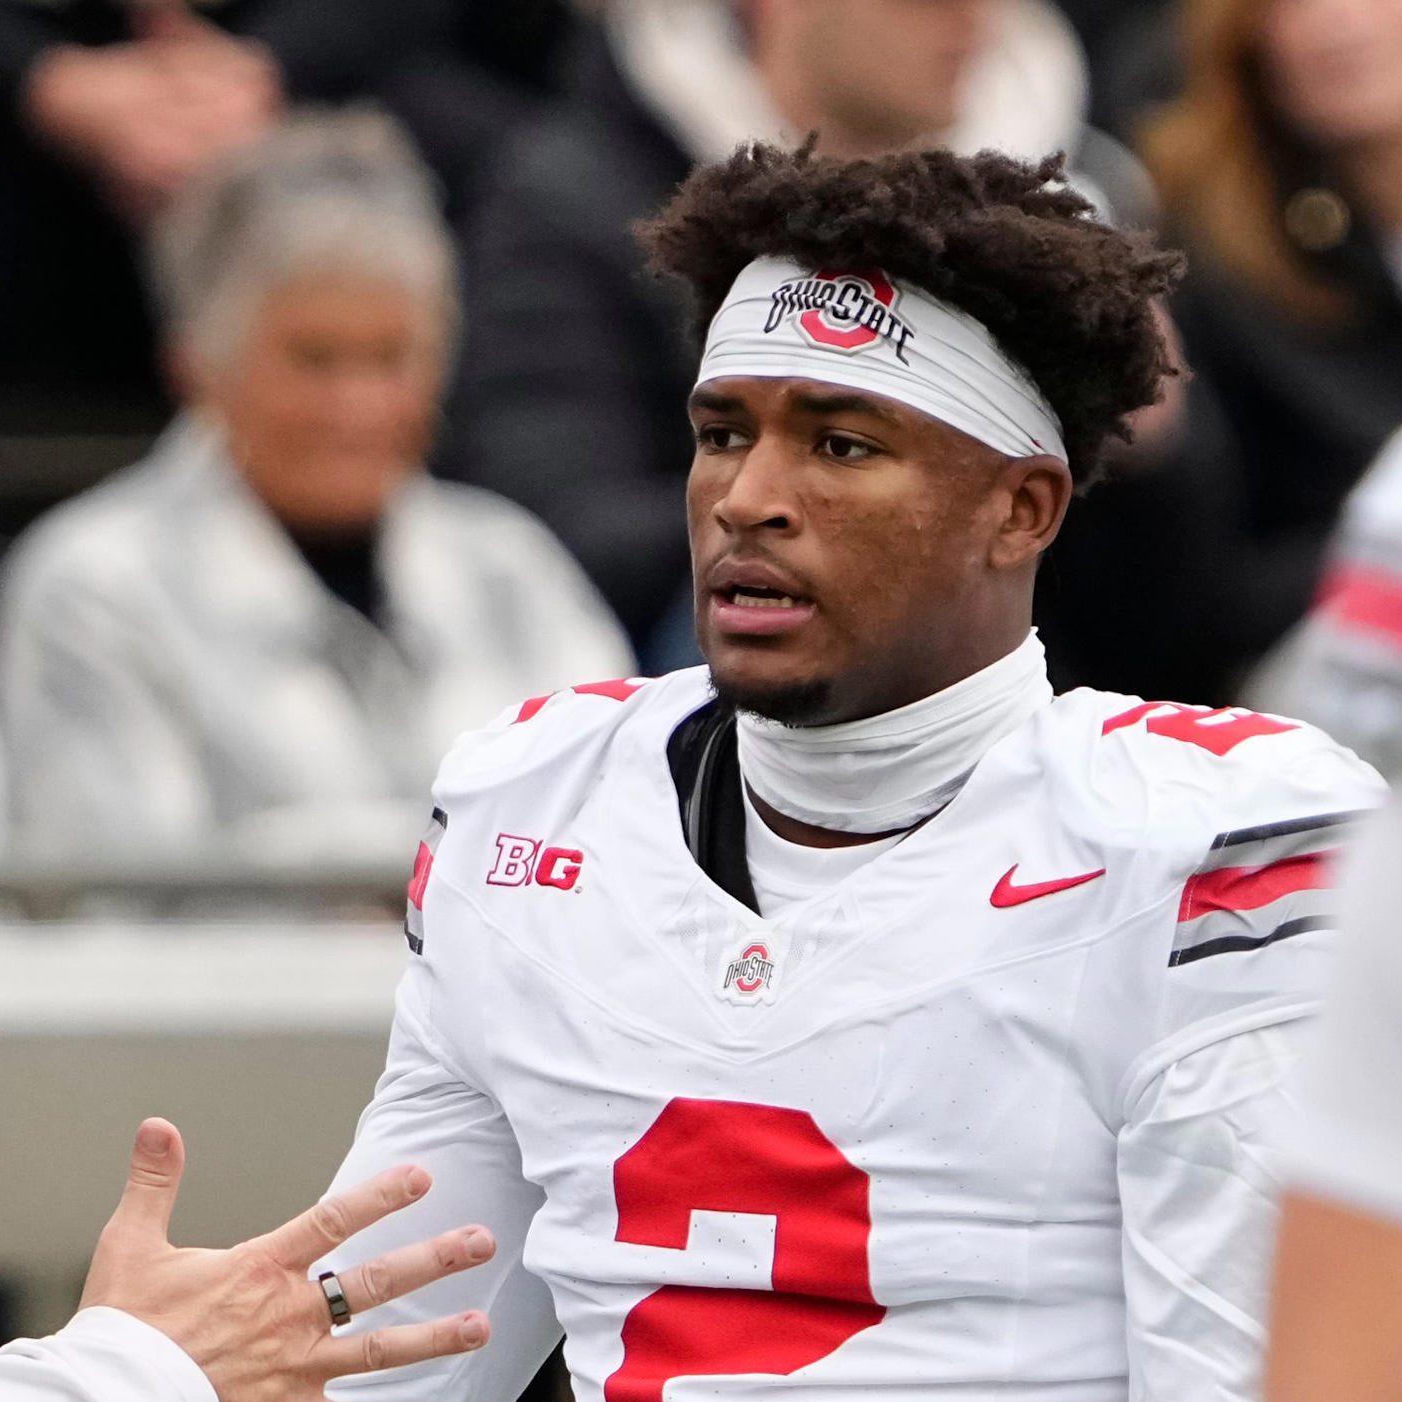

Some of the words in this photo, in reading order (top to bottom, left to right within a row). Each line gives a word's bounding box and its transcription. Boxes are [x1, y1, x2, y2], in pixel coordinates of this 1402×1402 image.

[763, 281, 837, 334] OHIO
[831, 283, 915, 367] STATE
[723, 959, 750, 989] OHIO
[747, 956, 775, 990] STATE
